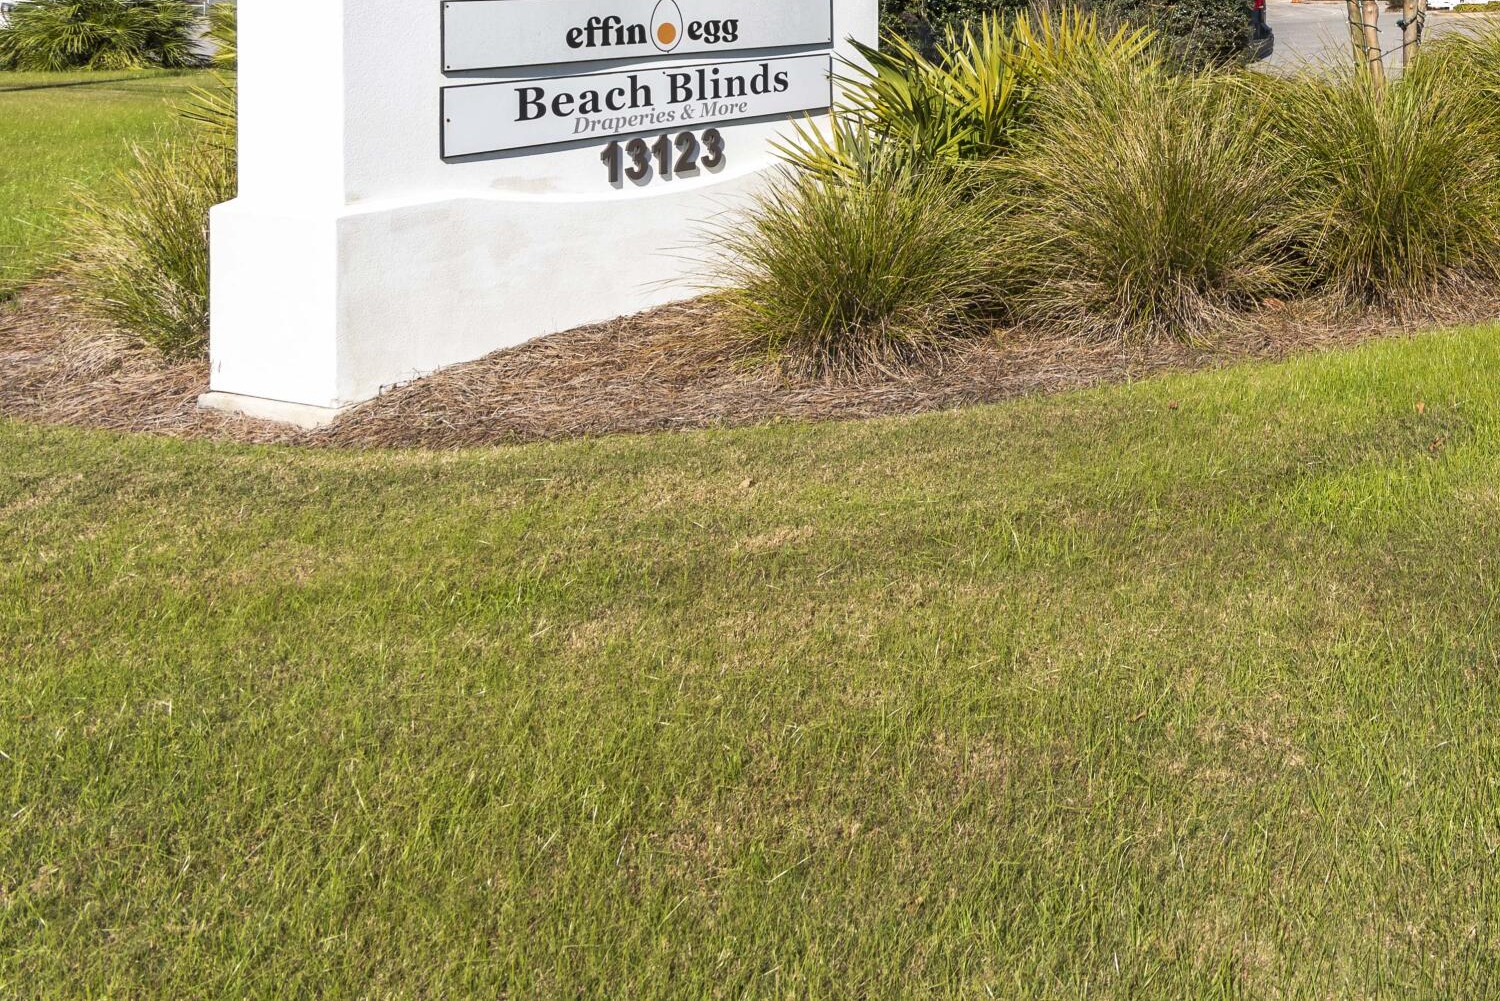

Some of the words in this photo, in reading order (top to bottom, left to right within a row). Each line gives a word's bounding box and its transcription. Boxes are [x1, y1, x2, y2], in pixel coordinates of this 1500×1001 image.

[566, 15, 648, 49] effin
[687, 19, 739, 45] egg
[514, 74, 654, 121] Beach
[666, 63, 789, 105] Blinds
[572, 107, 676, 135] Draperies
[680, 103, 695, 120] &
[699, 101, 748, 119] More
[600, 127, 726, 183] 13123
